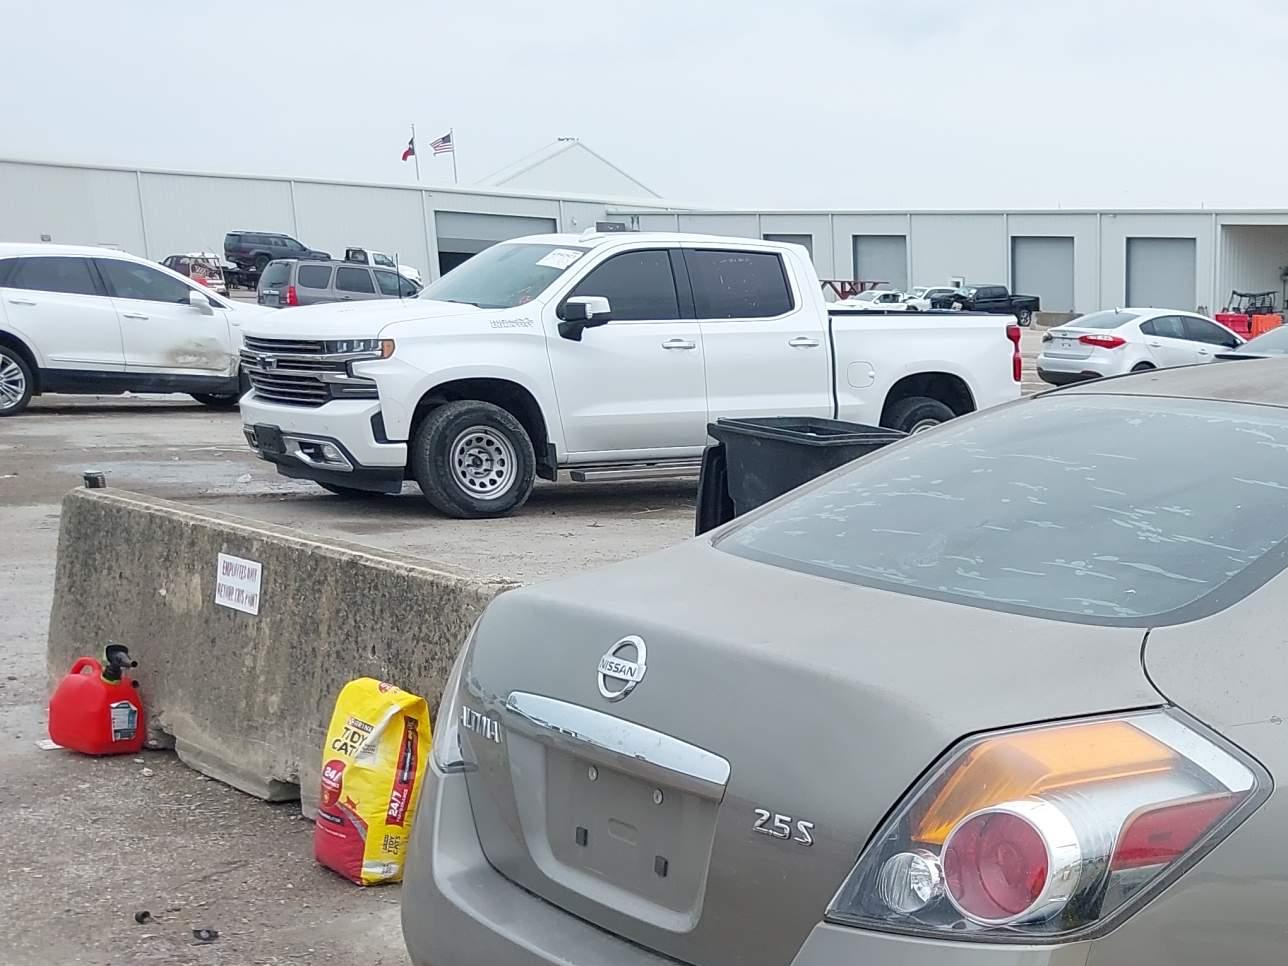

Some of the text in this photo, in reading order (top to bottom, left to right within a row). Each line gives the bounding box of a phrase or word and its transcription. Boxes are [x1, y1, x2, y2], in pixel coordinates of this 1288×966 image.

[600, 658, 637, 677] NISSAN
[342, 726, 368, 745] TIDY
[388, 790, 402, 817] 24/7
